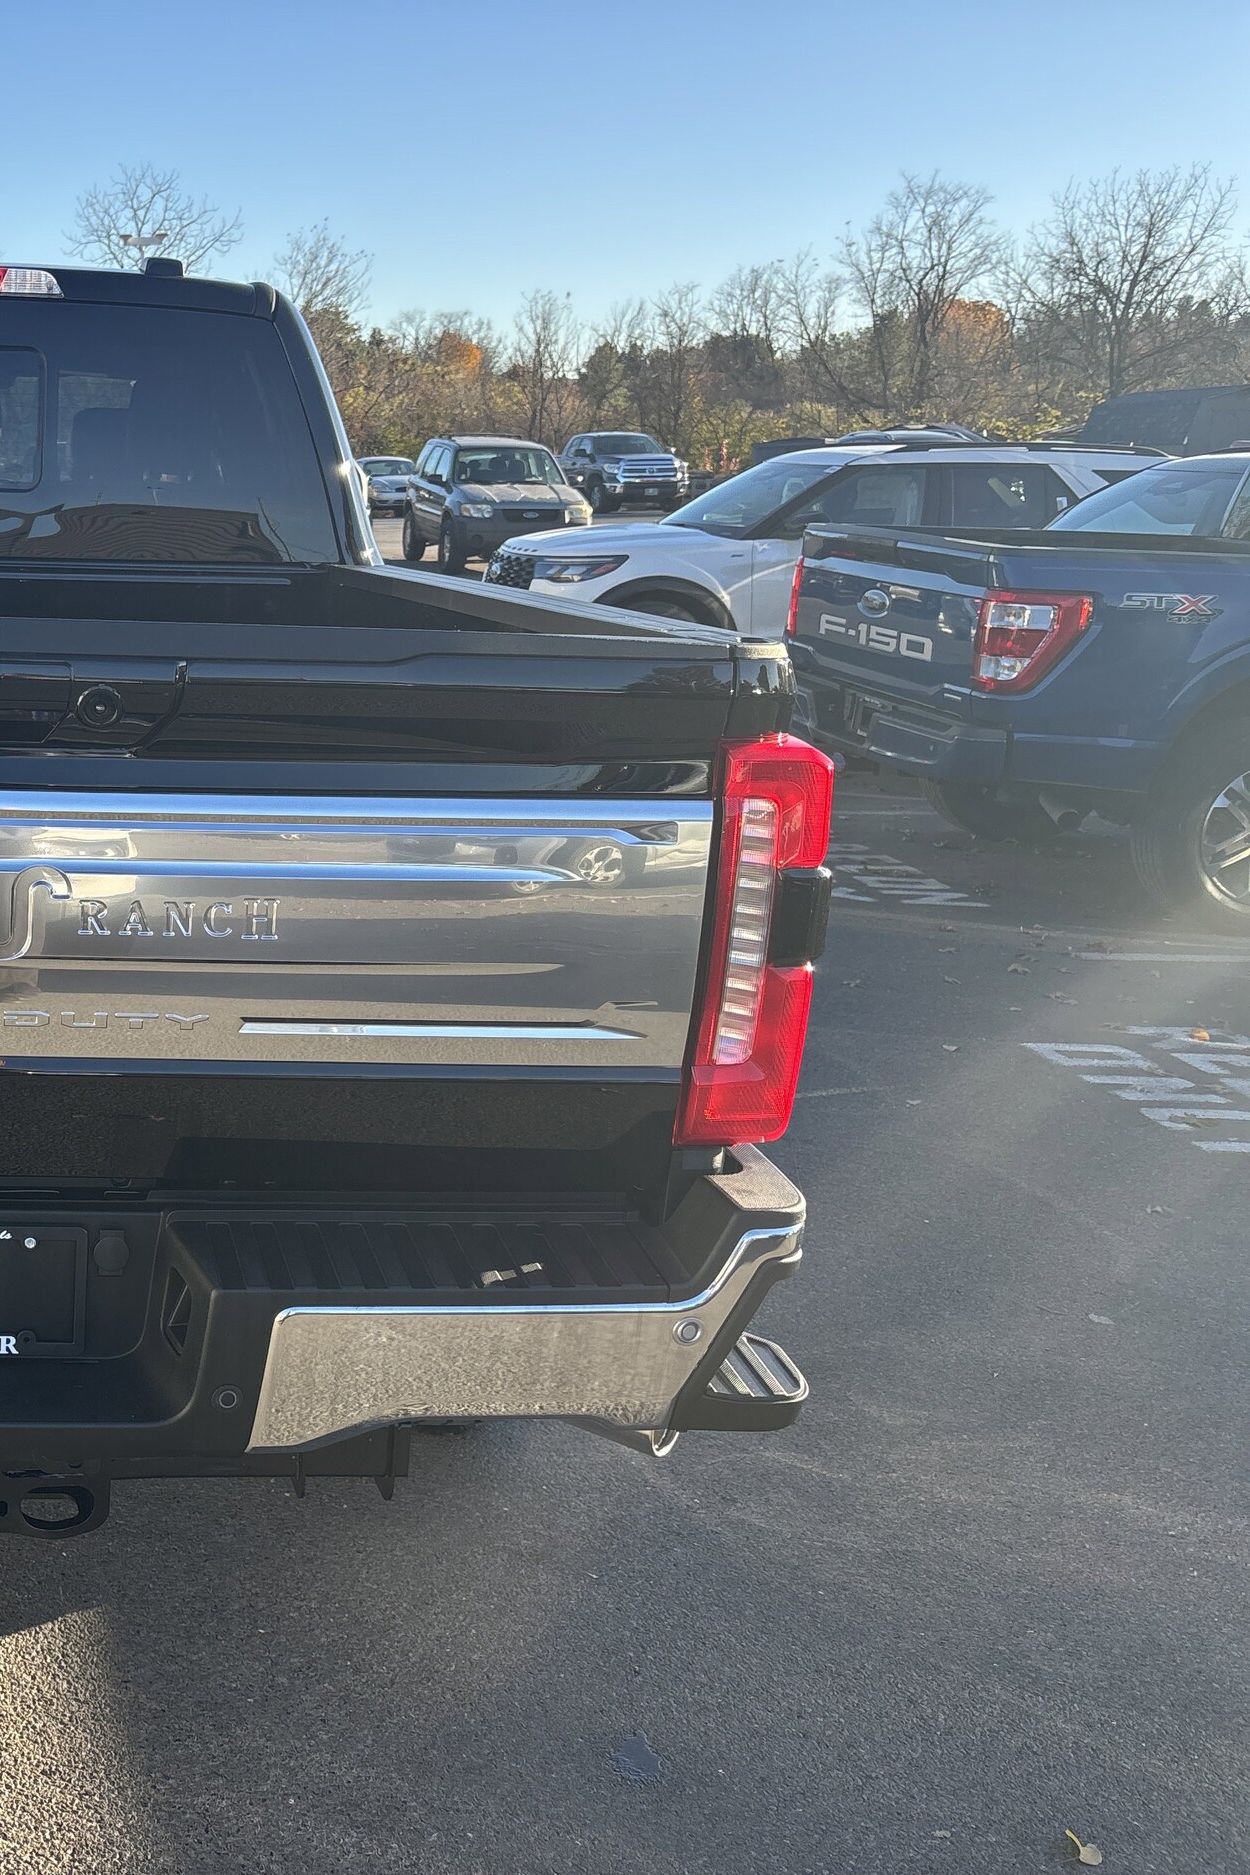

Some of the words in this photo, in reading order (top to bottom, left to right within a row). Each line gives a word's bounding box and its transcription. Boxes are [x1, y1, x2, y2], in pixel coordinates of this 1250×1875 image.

[1118, 592, 1219, 617] STX
[819, 613, 933, 662] F-150
[77, 897, 281, 941] RANCH
[3, 1009, 211, 1031] DUTY
